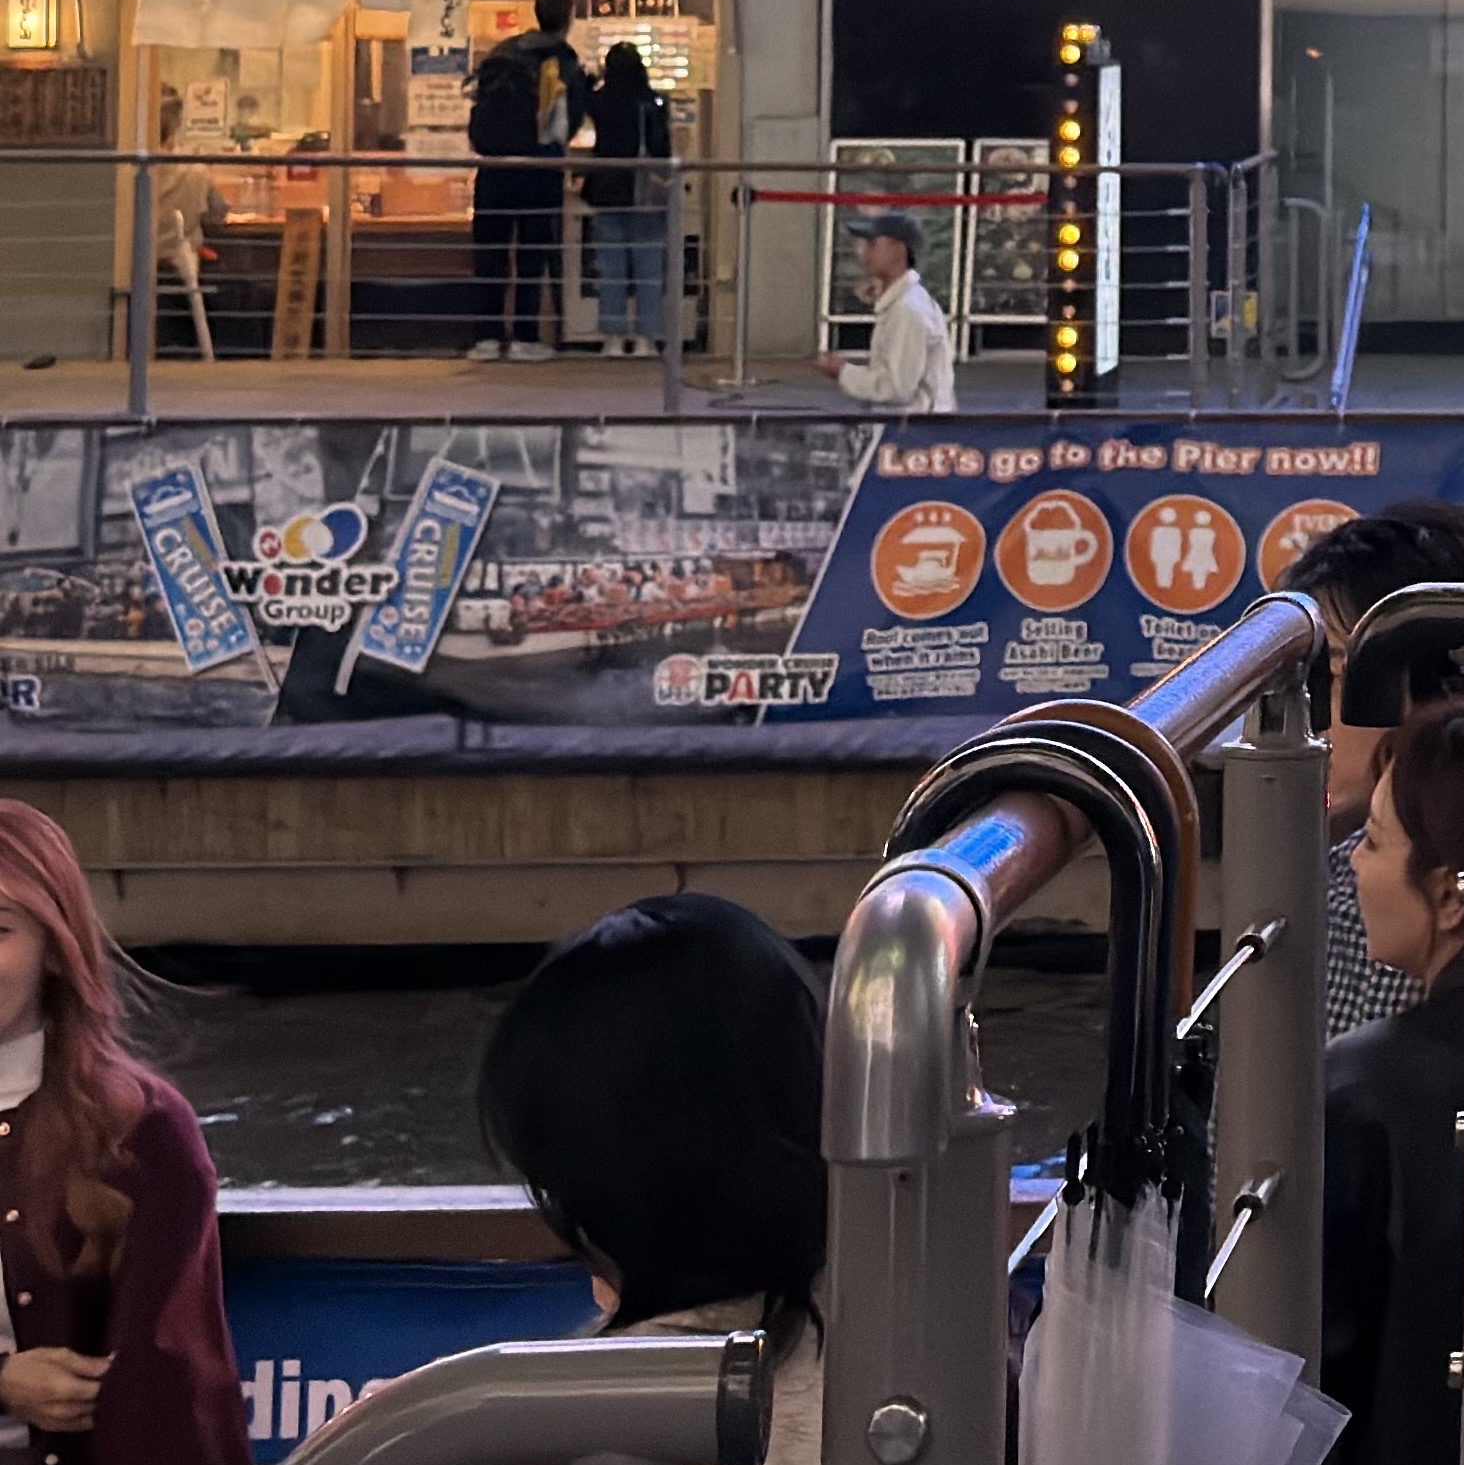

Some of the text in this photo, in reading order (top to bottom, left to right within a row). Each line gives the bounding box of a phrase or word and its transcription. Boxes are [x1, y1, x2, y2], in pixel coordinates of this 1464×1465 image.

[880, 441, 1378, 481] Let's go to the Pier now!!
[153, 527, 235, 639] CRUISE
[226, 566, 396, 597] Wonder
[402, 518, 442, 641] CRUISE
[263, 601, 346, 624] Group
[704, 672, 830, 700] PARTY
[241, 1359, 397, 1440] din
